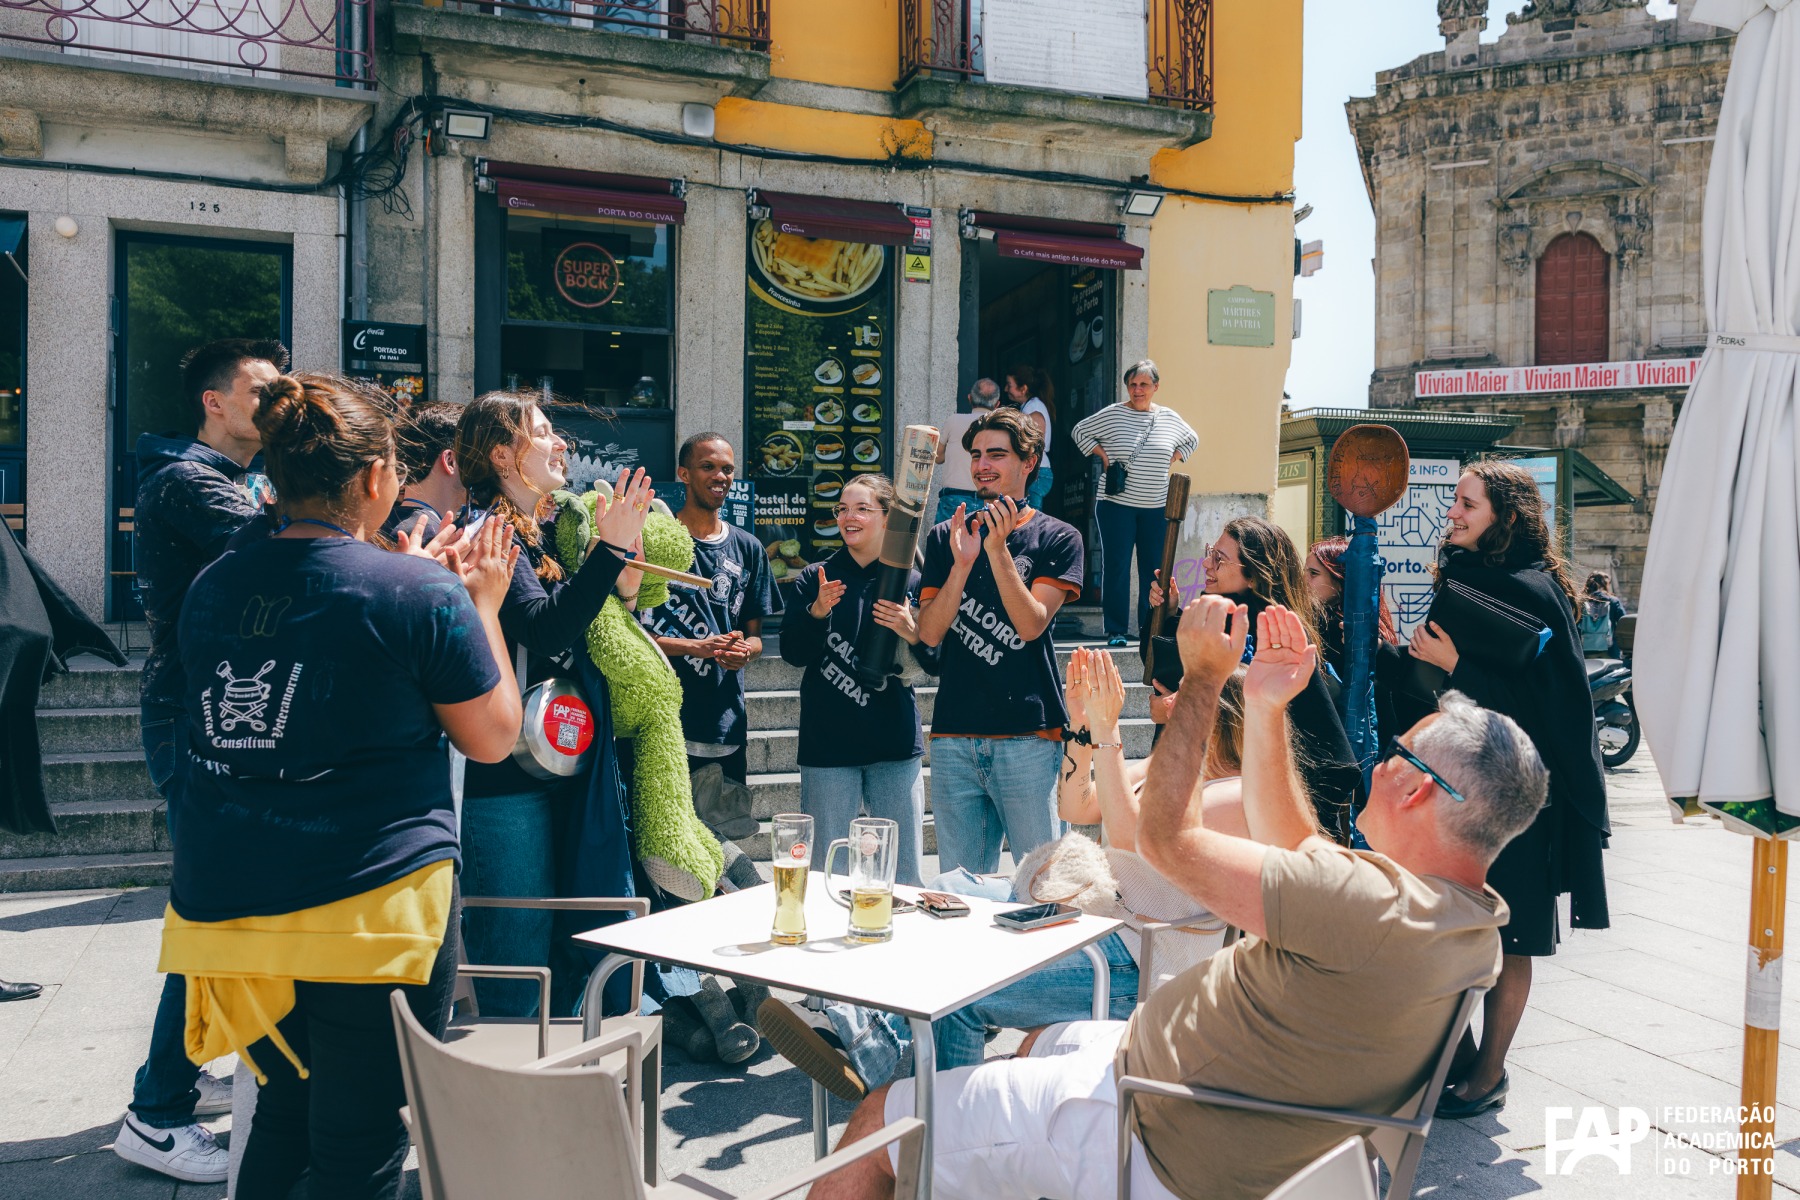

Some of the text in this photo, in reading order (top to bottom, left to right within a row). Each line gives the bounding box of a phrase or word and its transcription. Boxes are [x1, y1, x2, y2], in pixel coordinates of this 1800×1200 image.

[190, 201, 220, 214] 125
[598, 207, 676, 222] PORTA DO OLIVAL
[1020, 249, 1035, 257] Café
[1051, 253, 1071, 262] antigo
[1080, 256, 1100, 264] cidade
[1100, 257, 1109, 265] do
[1110, 258, 1127, 266] Porto
[563, 259, 611, 276] SUPER
[565, 275, 609, 290] BOCK
[767, 287, 801, 308] Francesinha
[1084, 296, 1099, 312] Porto
[1222, 319, 1232, 328] DA
[1716, 335, 1746, 347] PEDRAS
[373, 346, 398, 354] PORTAS
[1418, 372, 1463, 395] Vivian
[1466, 370, 1509, 393] Maier
[1524, 368, 1572, 391] Vivian
[1575, 365, 1620, 389] Maier
[1636, 362, 1686, 386] Vivian
[1409, 465, 1448, 476] & INFO
[754, 492, 807, 505] Pastel de
[774, 518, 805, 526] QUEIJO
[820, 655, 871, 707] ETRAS
[271, 662, 304, 739] Veteranorum
[553, 703, 570, 718] FAP
[212, 735, 276, 749] Consilium
